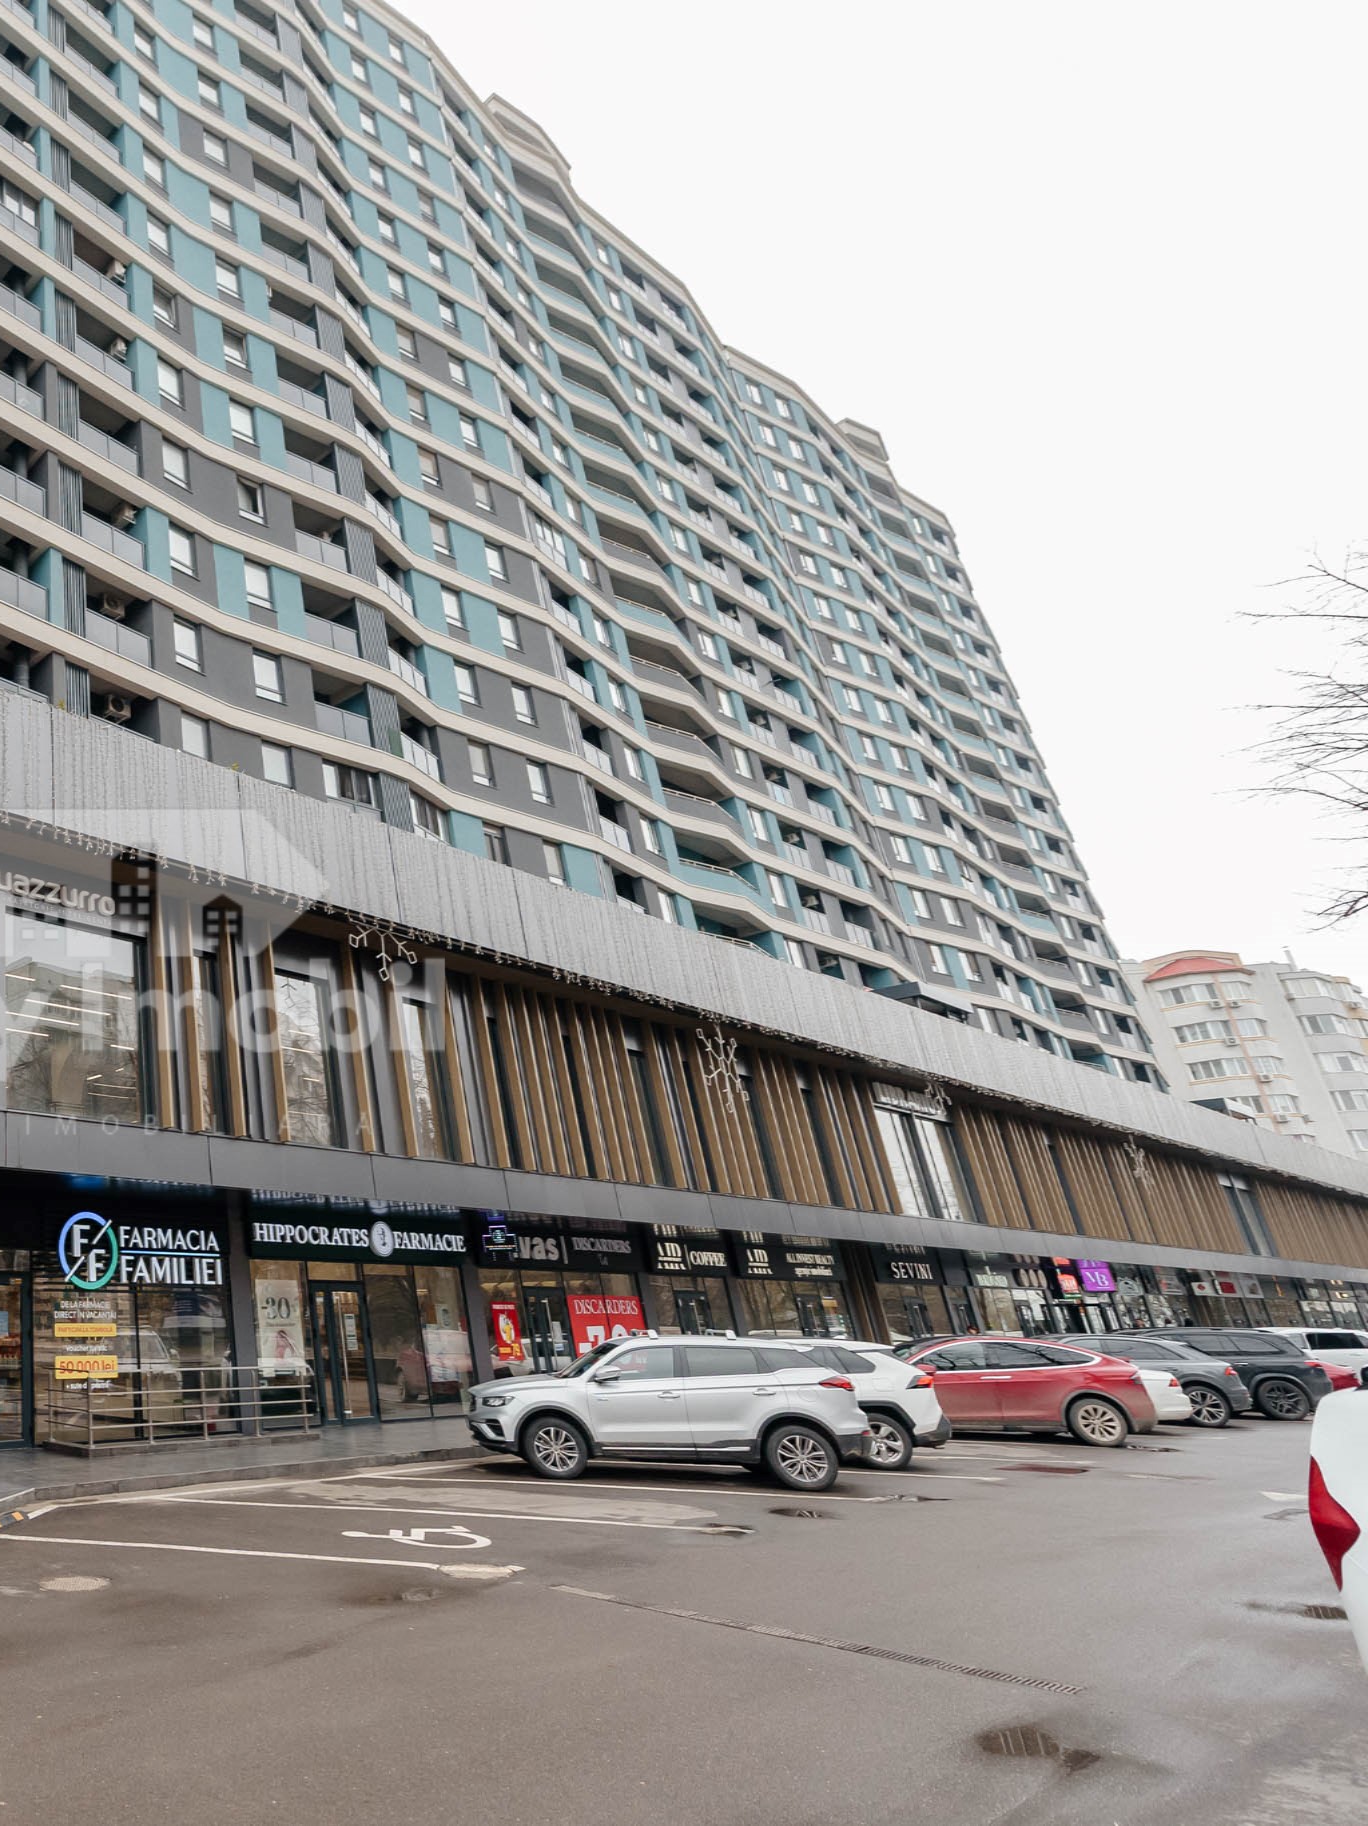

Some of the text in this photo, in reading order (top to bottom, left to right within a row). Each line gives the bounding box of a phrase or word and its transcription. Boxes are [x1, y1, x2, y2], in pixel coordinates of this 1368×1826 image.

[119, 1225, 220, 1251] FARMACIA
[252, 1222, 466, 1252] HIPPOCRATES FARMACIE
[690, 1250, 727, 1267] COFFEE
[119, 1255, 223, 1285] FAMILIEI
[890, 1262, 933, 1280] SEVINI
[574, 1299, 639, 1315] DISCARDERS
